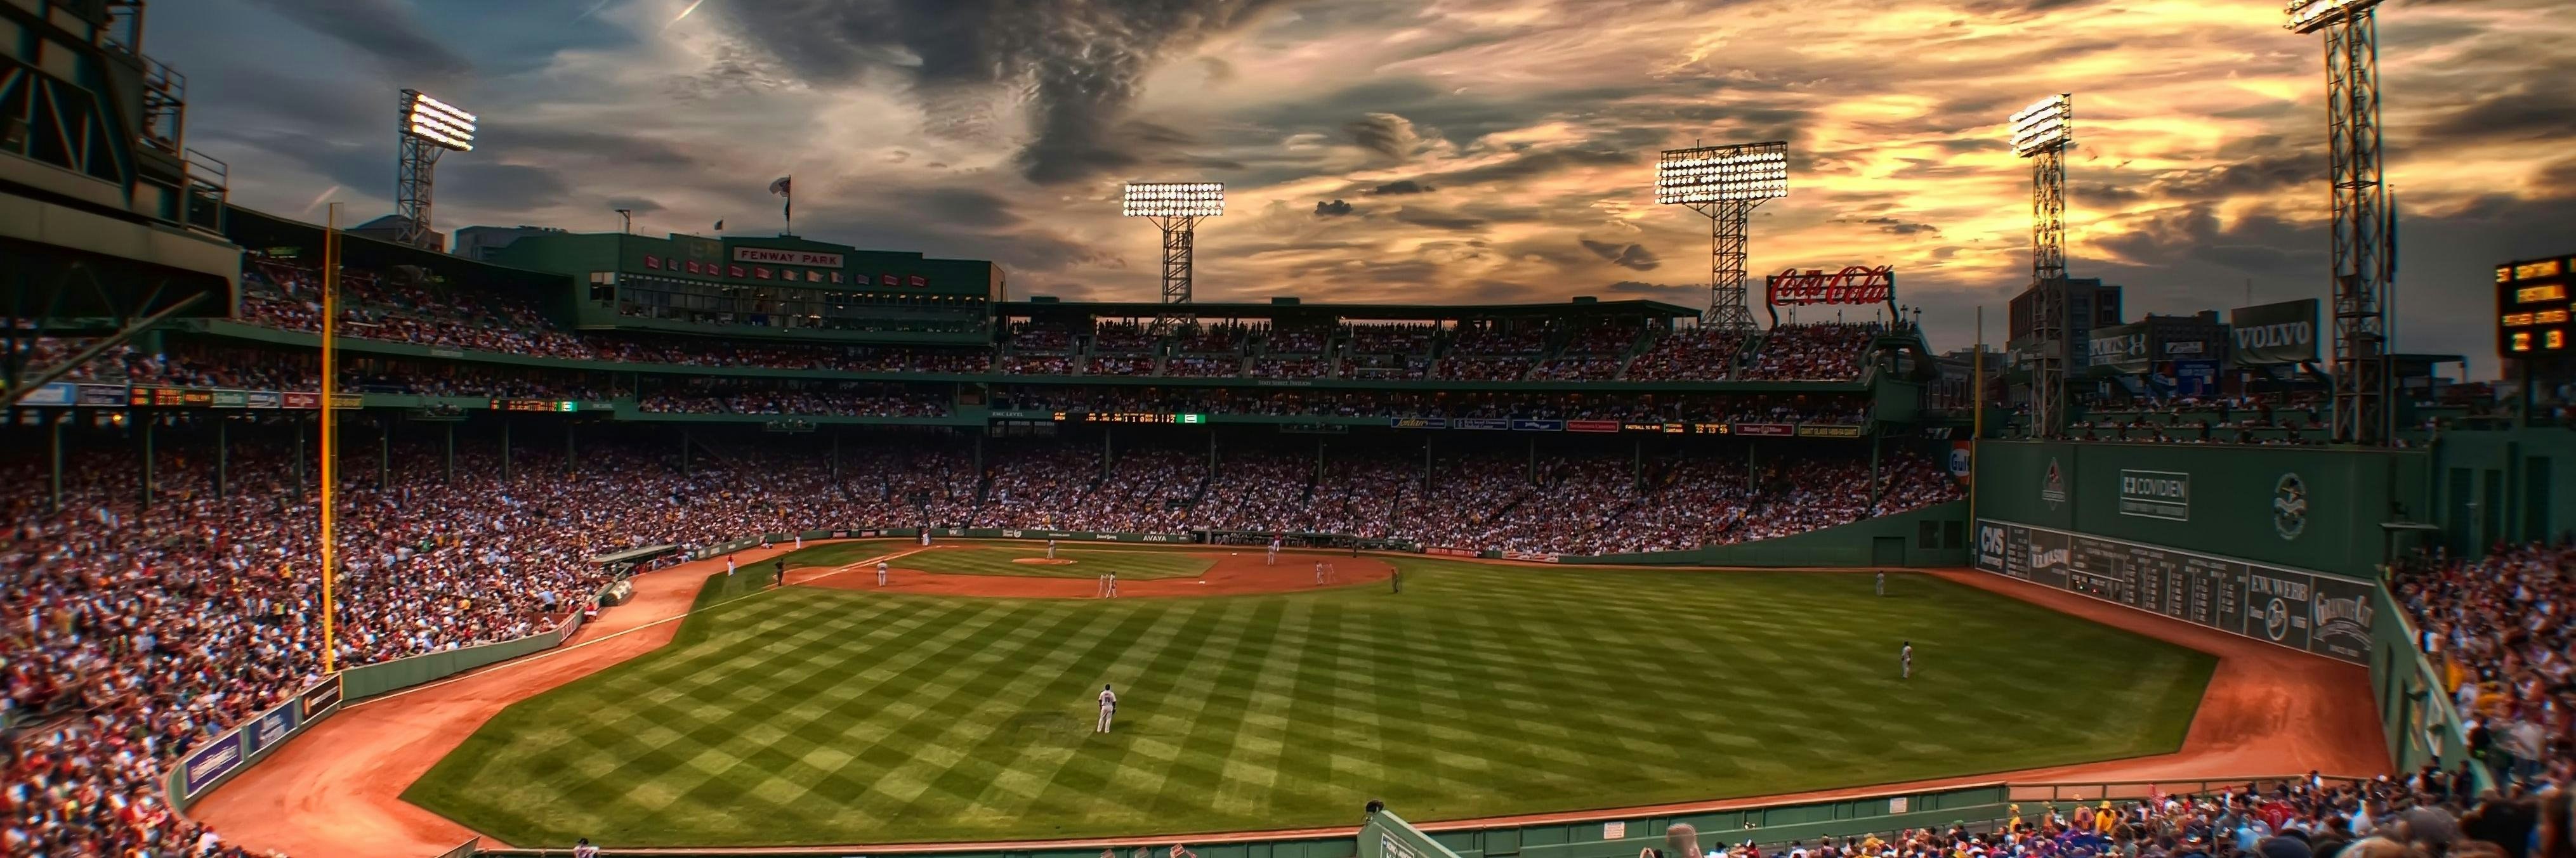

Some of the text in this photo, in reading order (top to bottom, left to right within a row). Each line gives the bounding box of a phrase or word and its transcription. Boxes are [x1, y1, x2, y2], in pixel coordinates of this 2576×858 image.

[741, 249, 838, 265] FENWAY PARK
[1771, 265, 1893, 306] Coca-Cola
[2235, 321, 2310, 349] VOLVO
[2137, 478, 2185, 497] COVIDIEN
[1980, 526, 2005, 555] CVS
